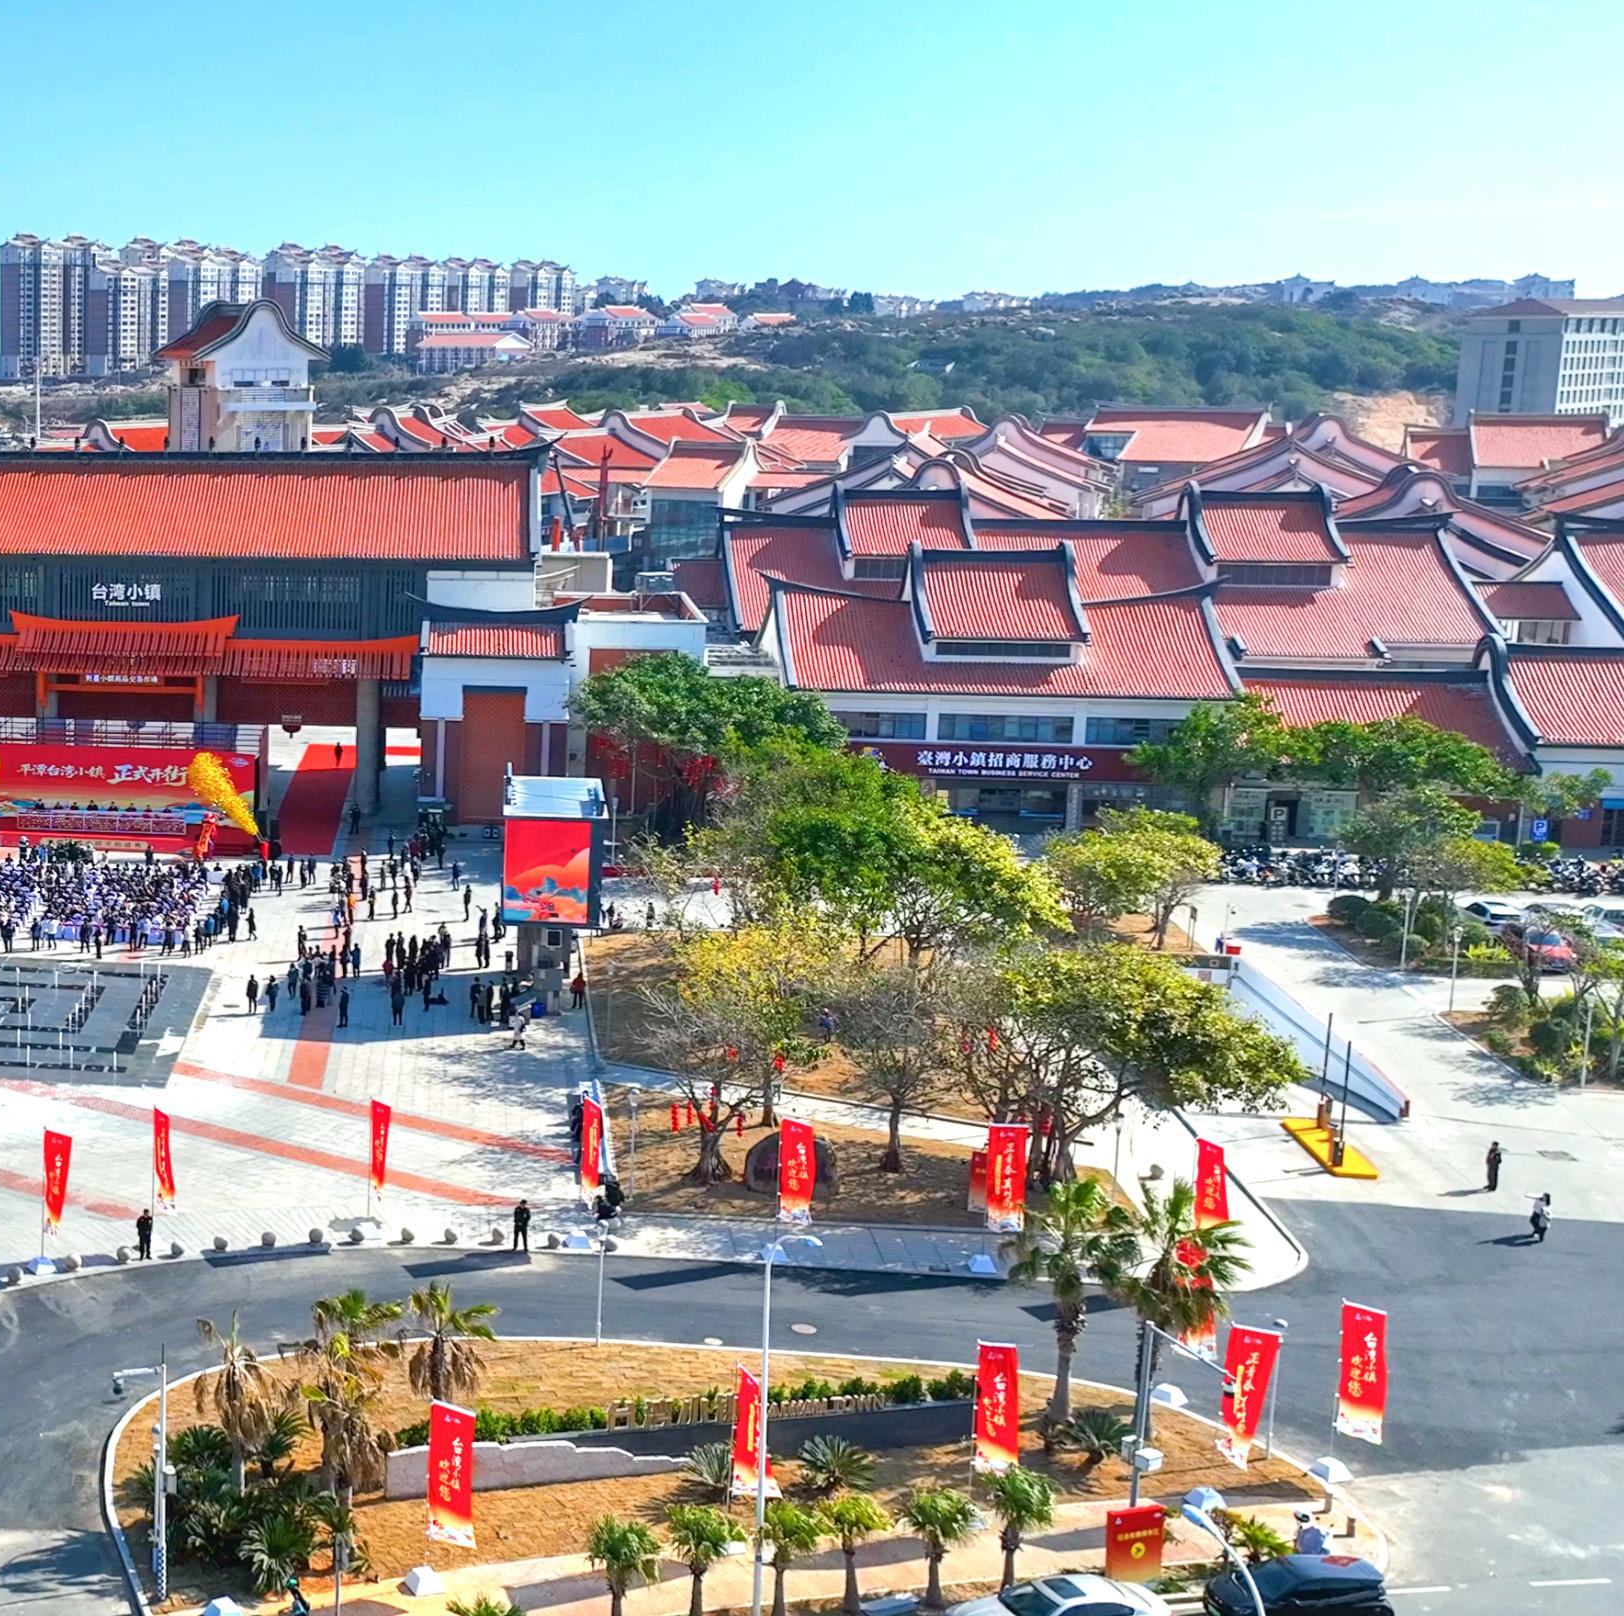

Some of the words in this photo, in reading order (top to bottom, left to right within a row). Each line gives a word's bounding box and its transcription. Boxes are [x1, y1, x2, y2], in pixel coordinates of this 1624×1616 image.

[91, 583, 161, 601] 台湾小镇
[917, 750, 1093, 770] 臺灣小鎮招商服務中心
[106, 763, 189, 787] 正式开街
[928, 767, 956, 775] TAIWAN
[981, 769, 1016, 777] BUSINESS
[1363, 1331, 1378, 1383] 台湾小镇
[767, 1398, 828, 1419] AIWAN
[452, 1436, 464, 1492] 台湾小镇
